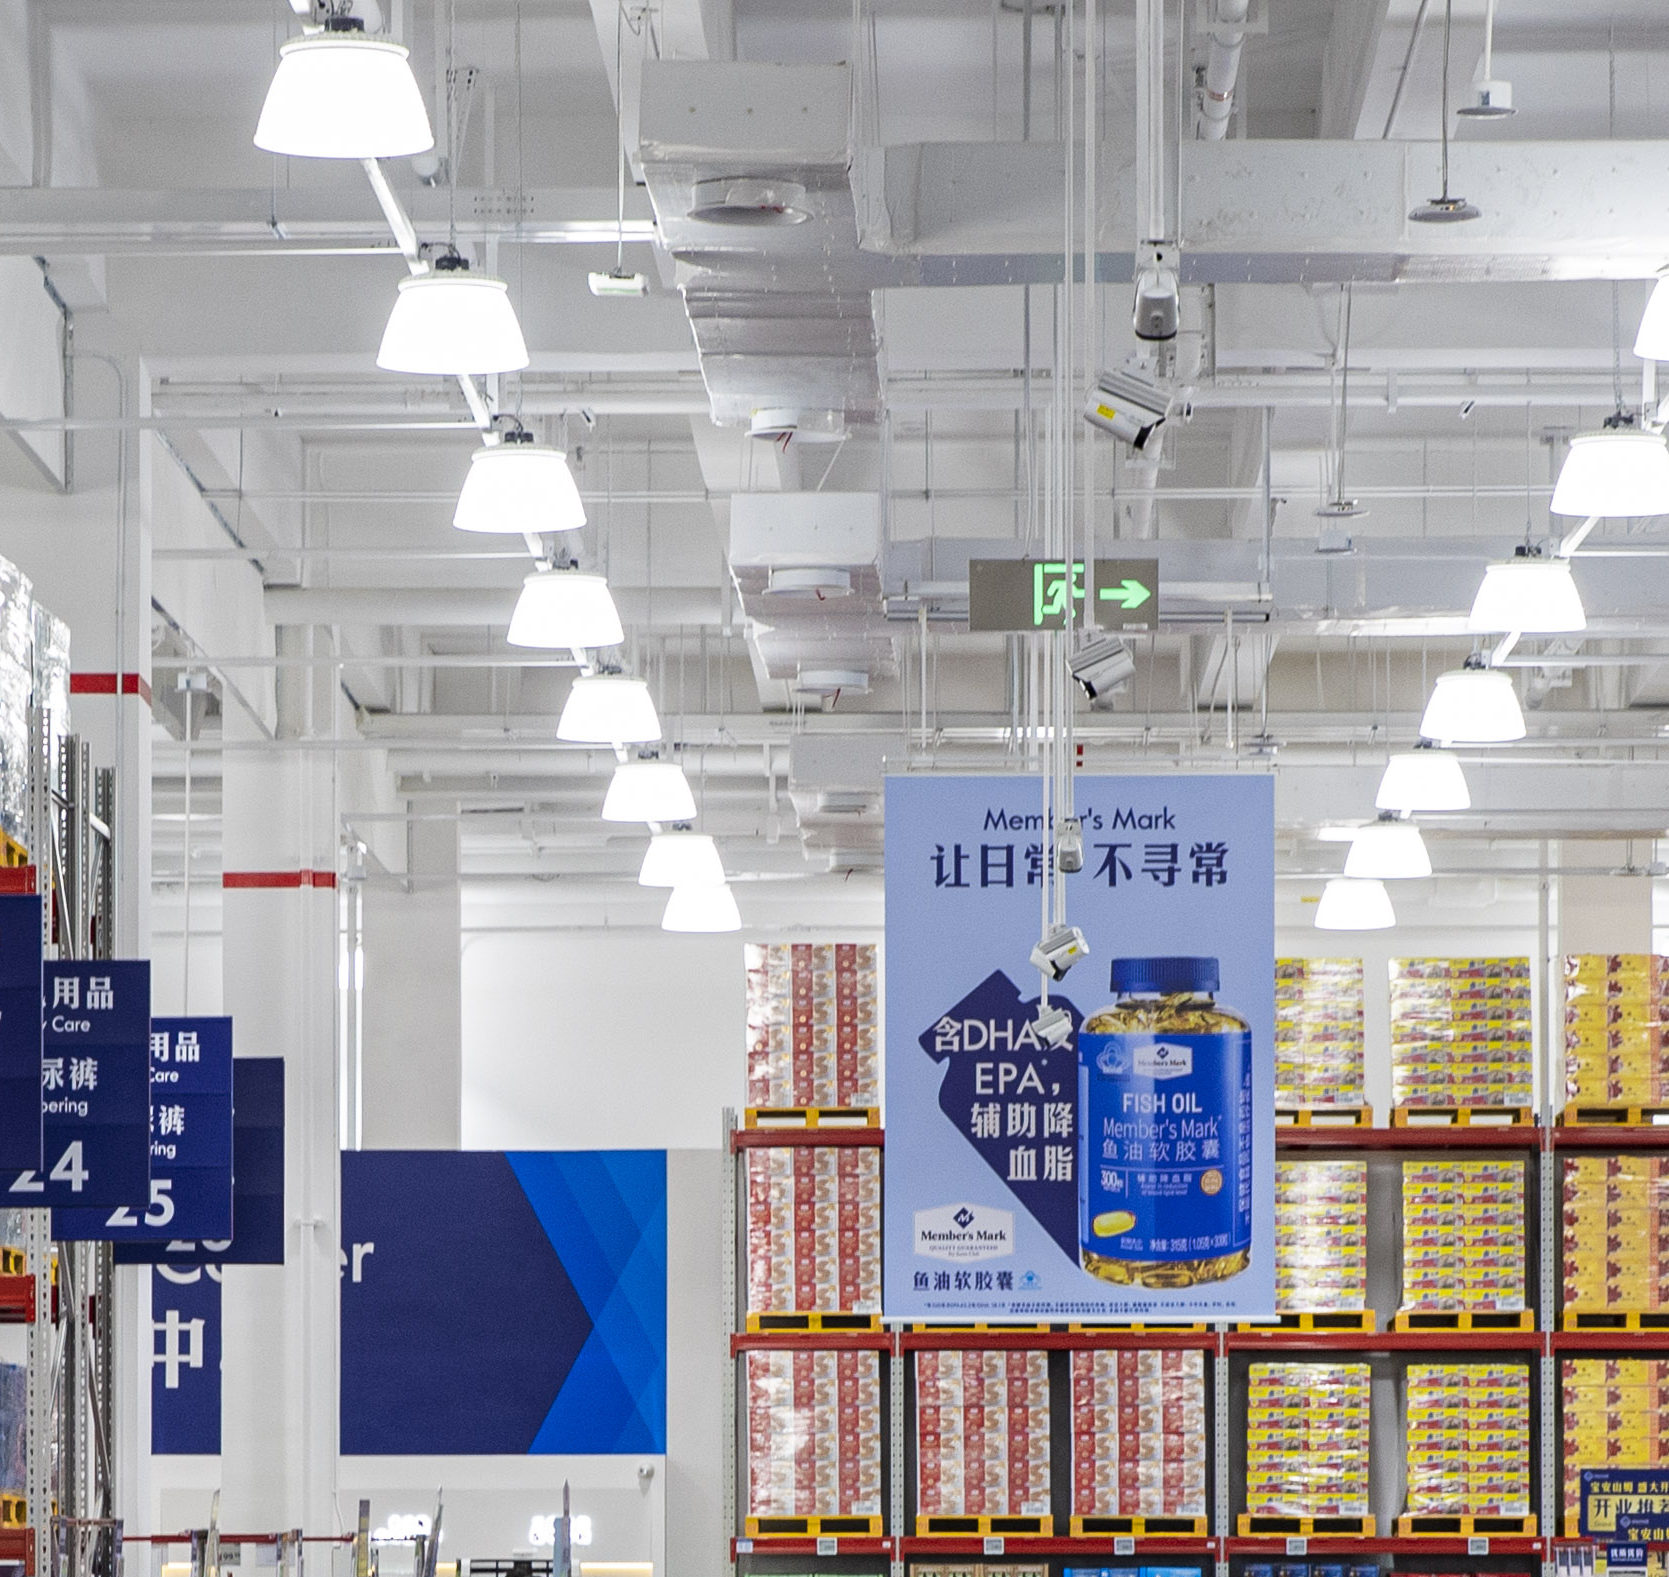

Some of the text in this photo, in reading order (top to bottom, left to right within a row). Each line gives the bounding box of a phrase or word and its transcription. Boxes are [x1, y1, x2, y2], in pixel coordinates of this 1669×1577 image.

[1112, 806, 1176, 830] Mark
[43, 976, 114, 1011] 用品
[52, 1016, 90, 1033] Care
[1122, 1092, 1203, 1114] FISH OIL
[971, 1102, 1073, 1139] 辅助降
[1103, 1116, 1178, 1139] Member's
[1102, 1138, 1220, 1162] 鱼油软胶囊
[1007, 1145, 1073, 1182] 血脂
[921, 1230, 1007, 1242] Member's Mark
[913, 1270, 1013, 1291] 鱼油软胶囊
[1590, 1481, 1634, 1494] 宝安山姆
